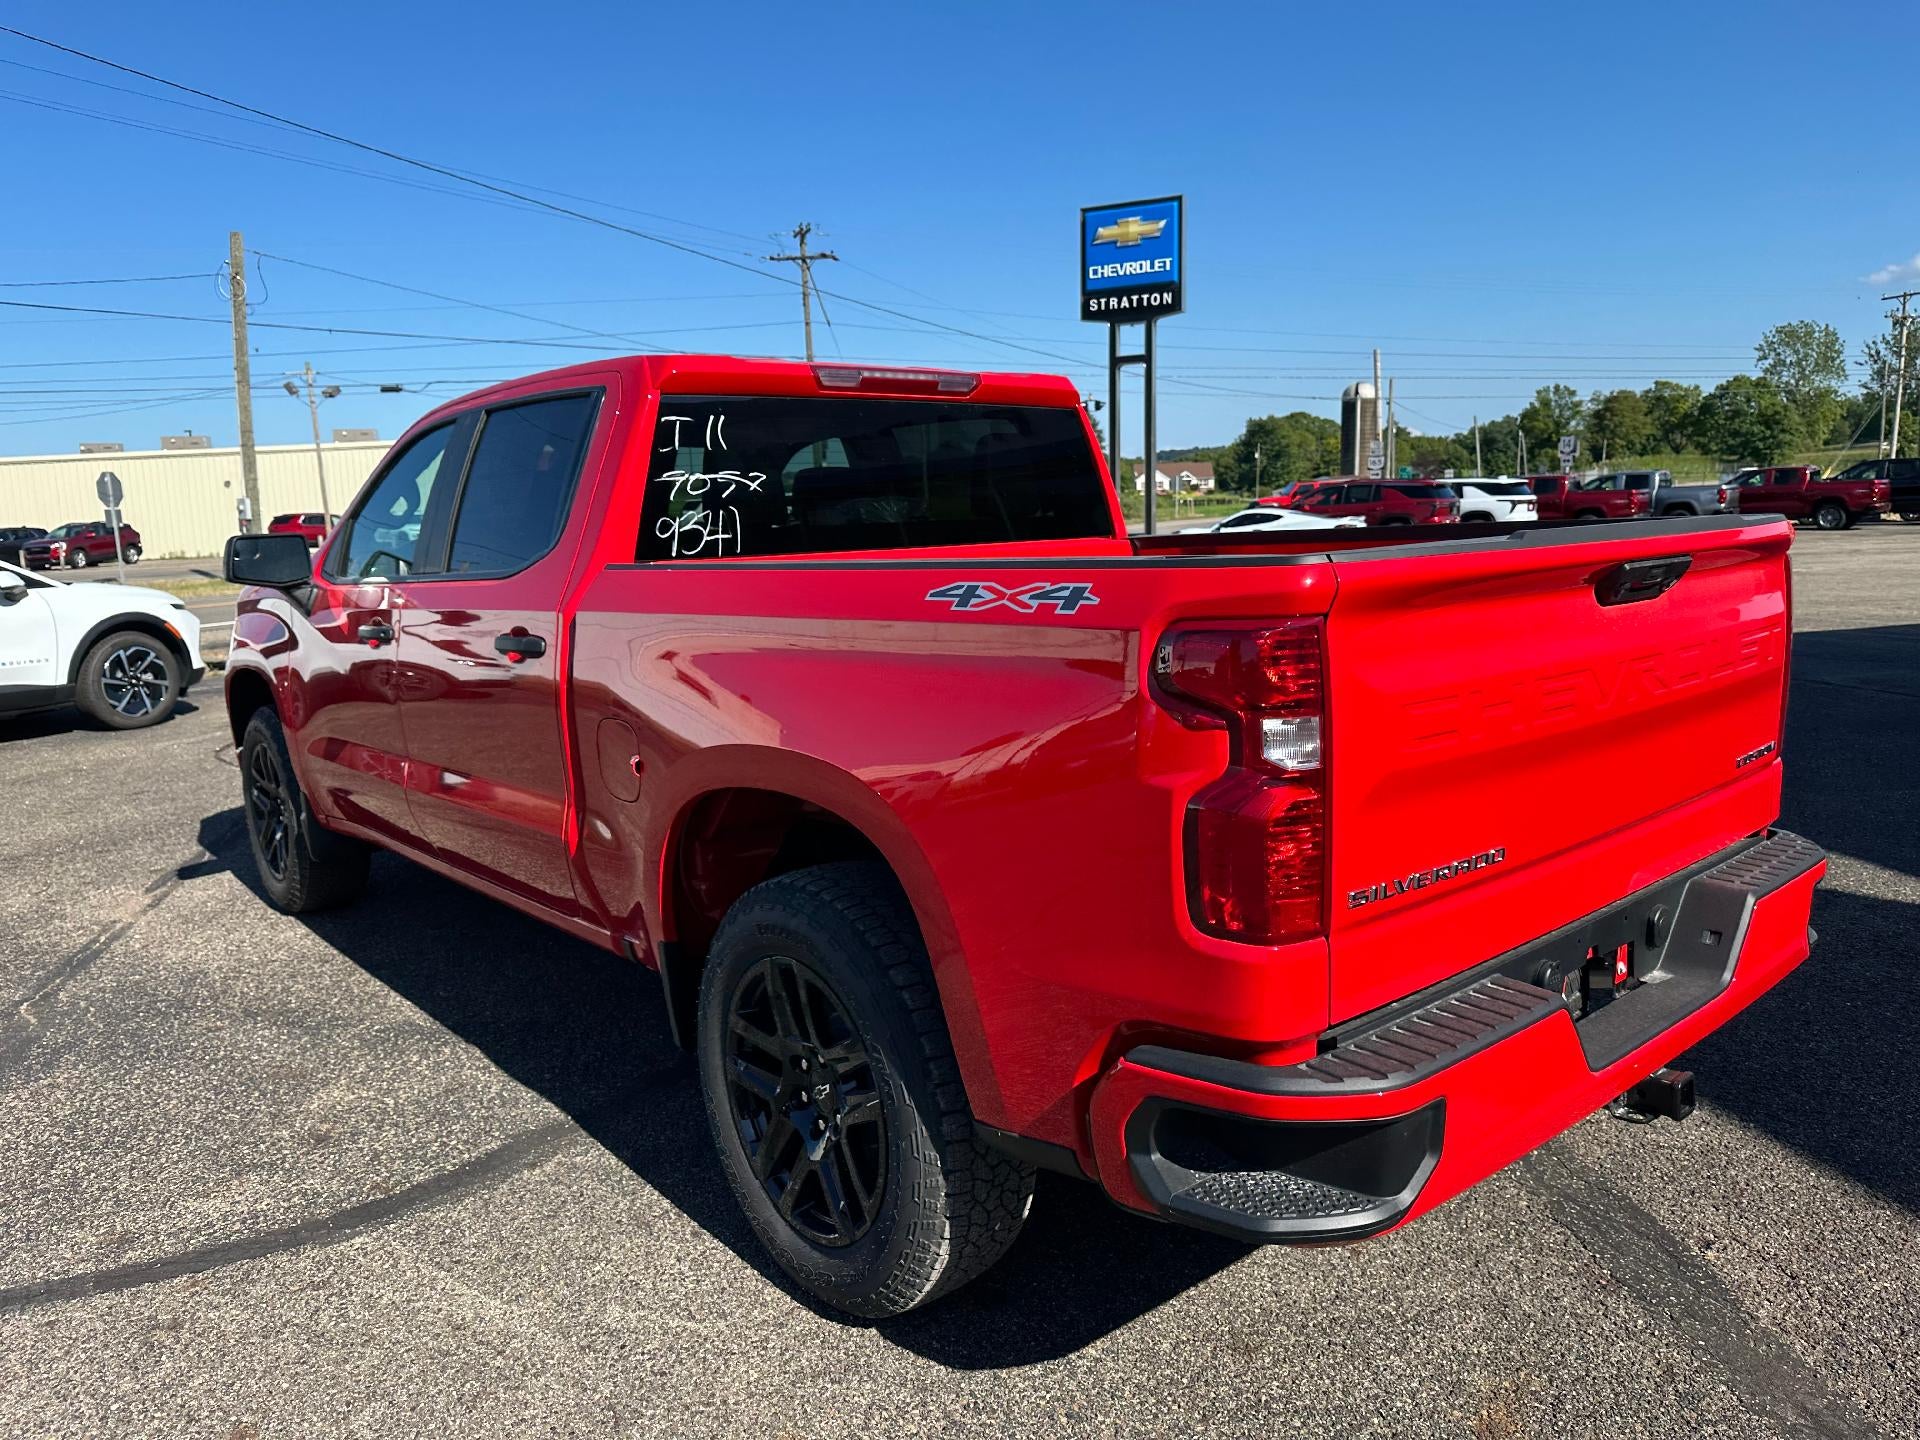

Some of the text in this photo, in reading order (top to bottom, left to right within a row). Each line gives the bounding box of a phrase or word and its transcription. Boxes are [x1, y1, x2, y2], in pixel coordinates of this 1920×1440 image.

[1088, 257, 1173, 279] CHEVROLET
[1089, 291, 1173, 312] STRATTON
[1347, 847, 1506, 910] SILVERADO
